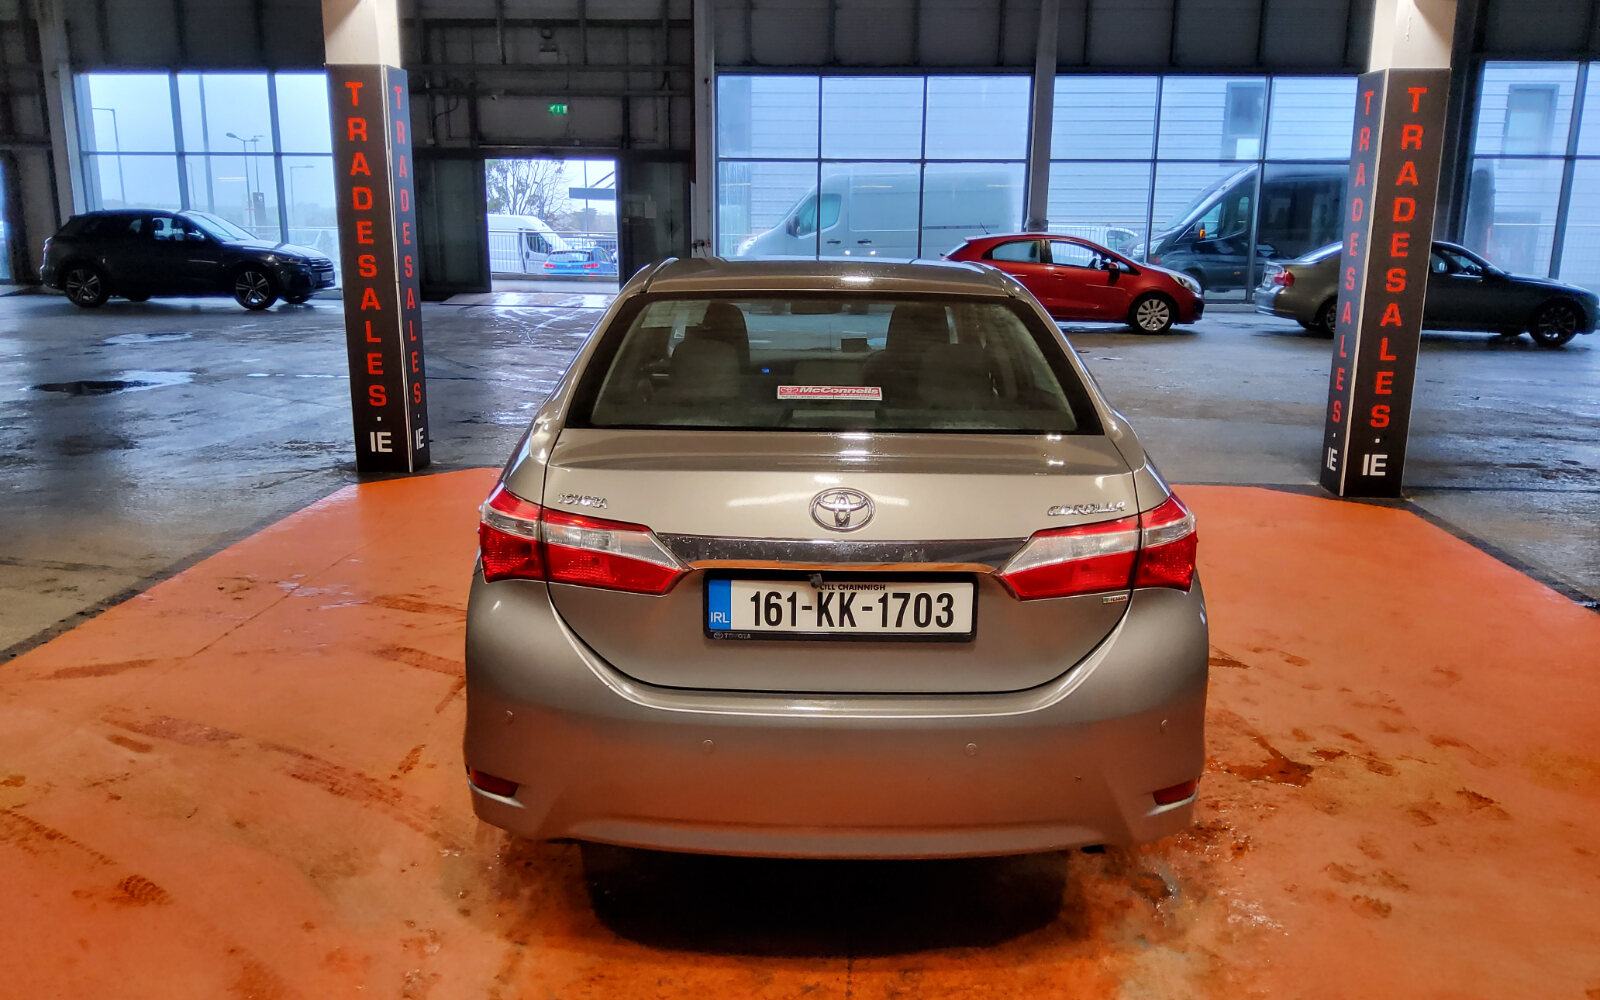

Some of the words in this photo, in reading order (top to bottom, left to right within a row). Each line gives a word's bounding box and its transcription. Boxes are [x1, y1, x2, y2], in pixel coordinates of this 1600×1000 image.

[799, 387, 879, 395] McConnells
[557, 493, 608, 509] TOYOTA
[1047, 501, 1125, 516] COROLLA
[837, 583, 886, 591] CHAINNIGH
[750, 591, 954, 628] 161-KK-1703
[710, 611, 730, 624] IRL
